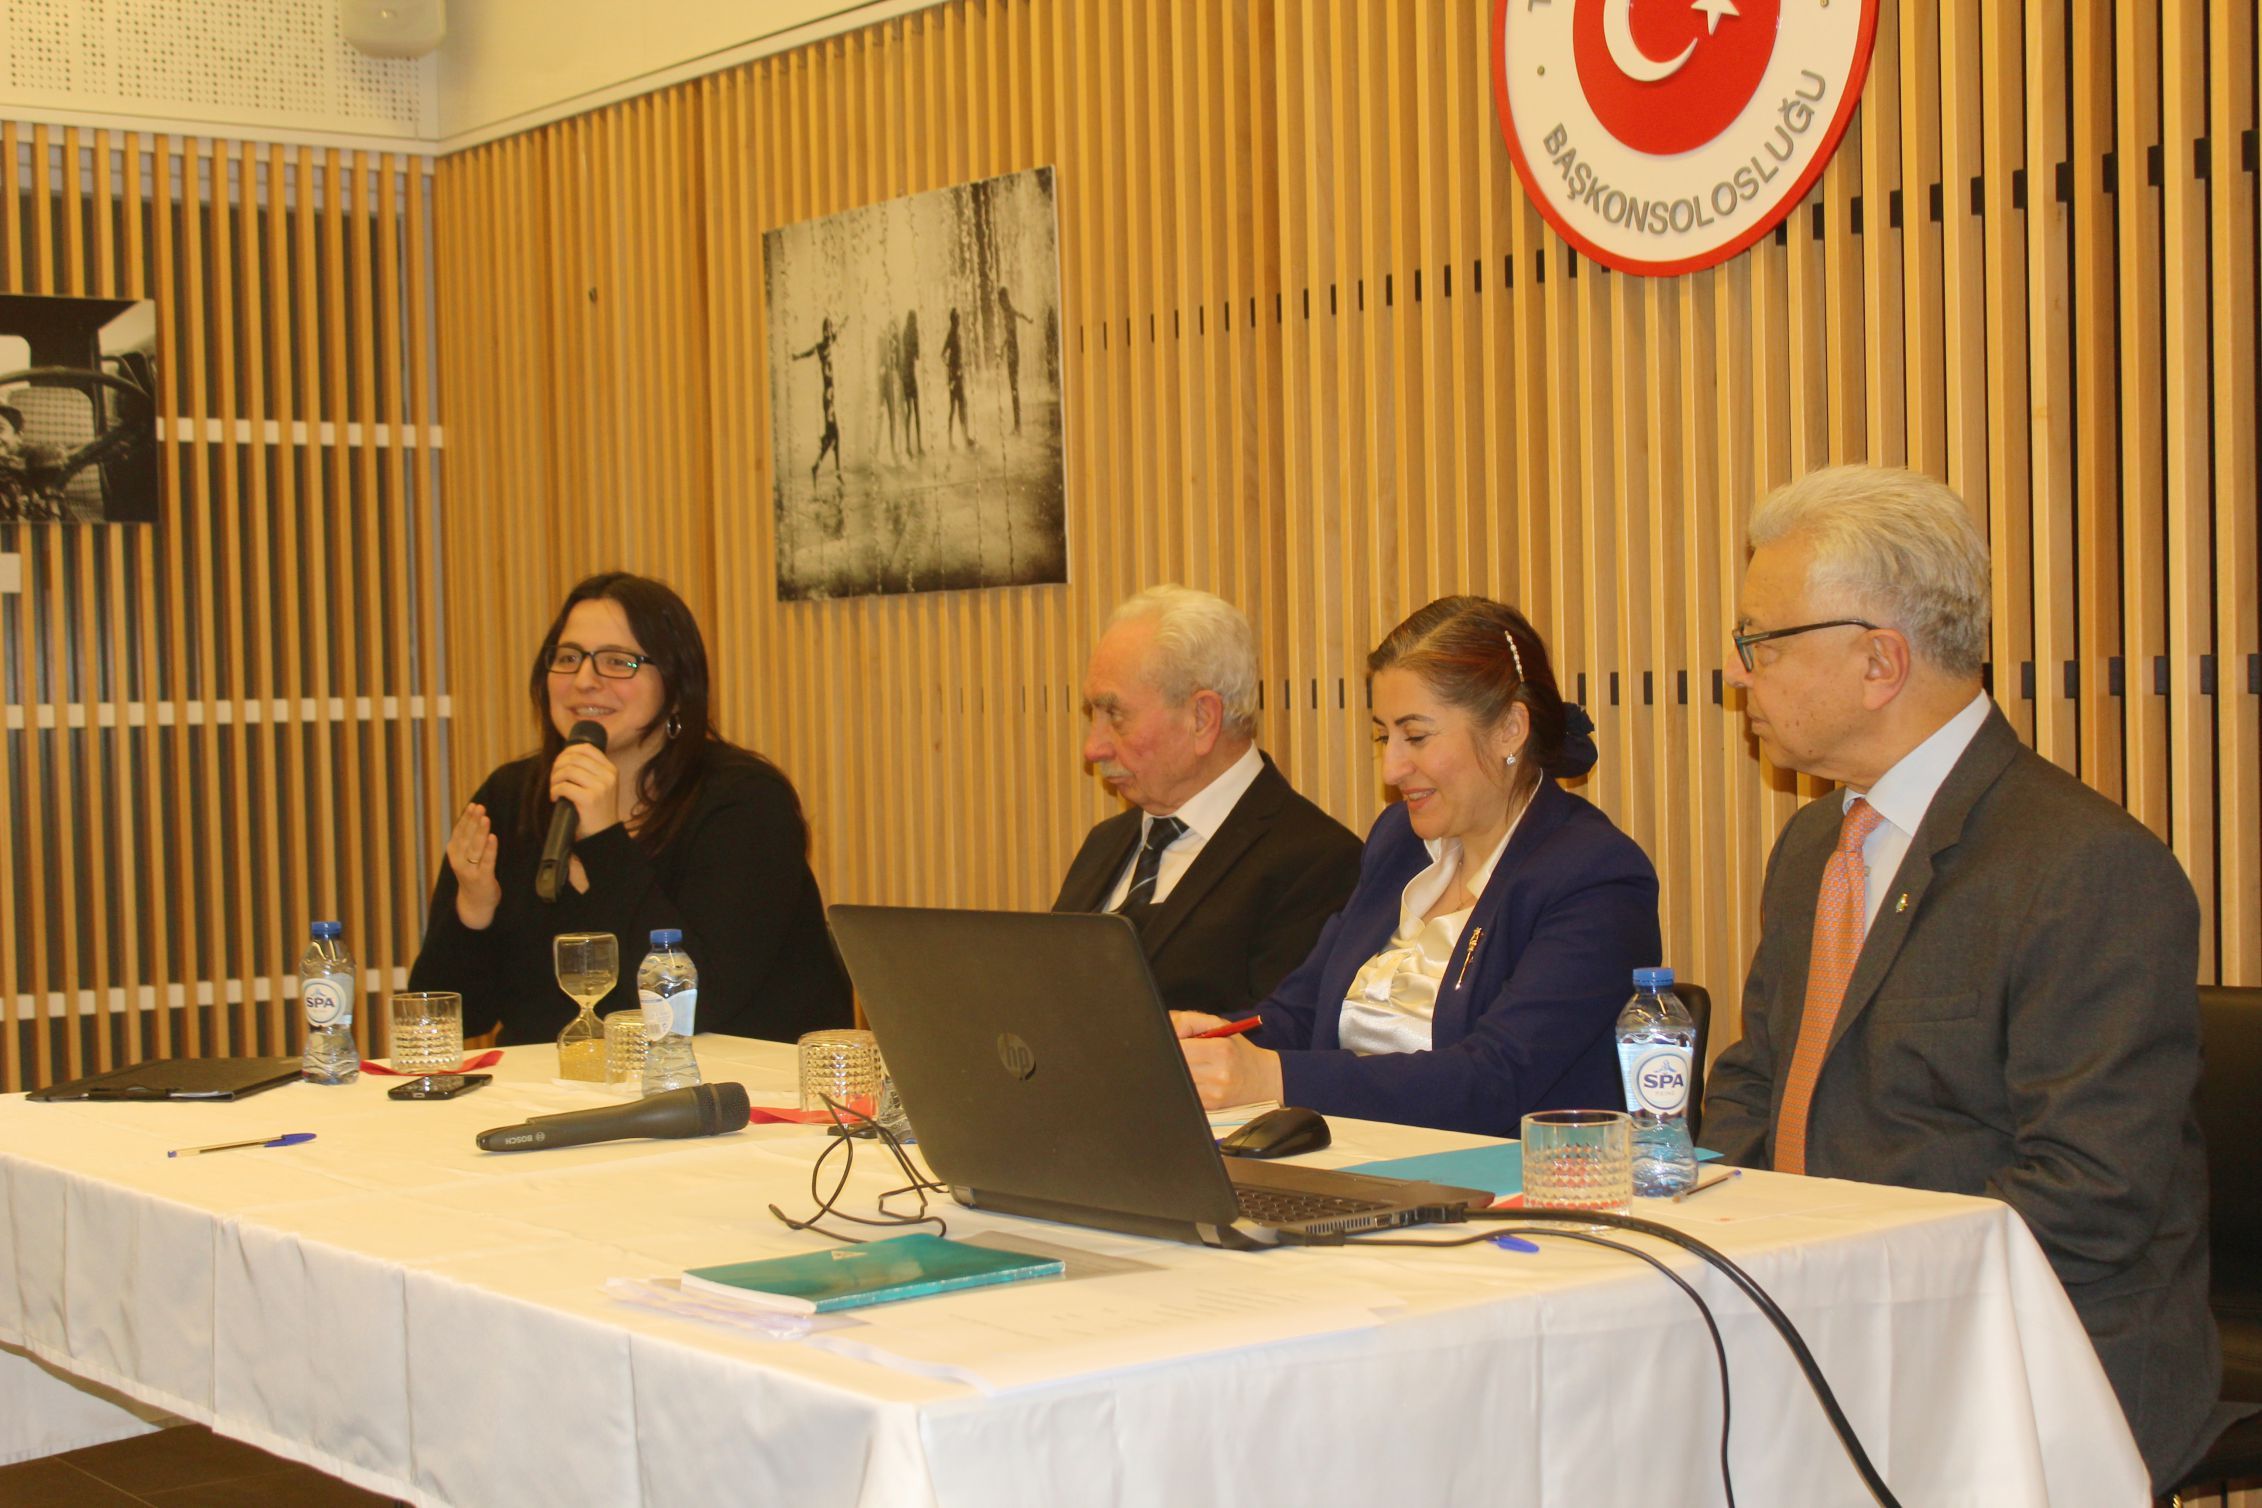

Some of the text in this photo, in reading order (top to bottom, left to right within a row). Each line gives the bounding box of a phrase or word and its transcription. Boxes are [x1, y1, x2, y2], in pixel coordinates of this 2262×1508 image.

[1542, 69, 1826, 235] BAŞKONSOLOSLUĞU
[305, 997, 335, 1008] SPA
[1643, 1073, 1684, 1089] SPA
[505, 1134, 533, 1145] BOSCH
